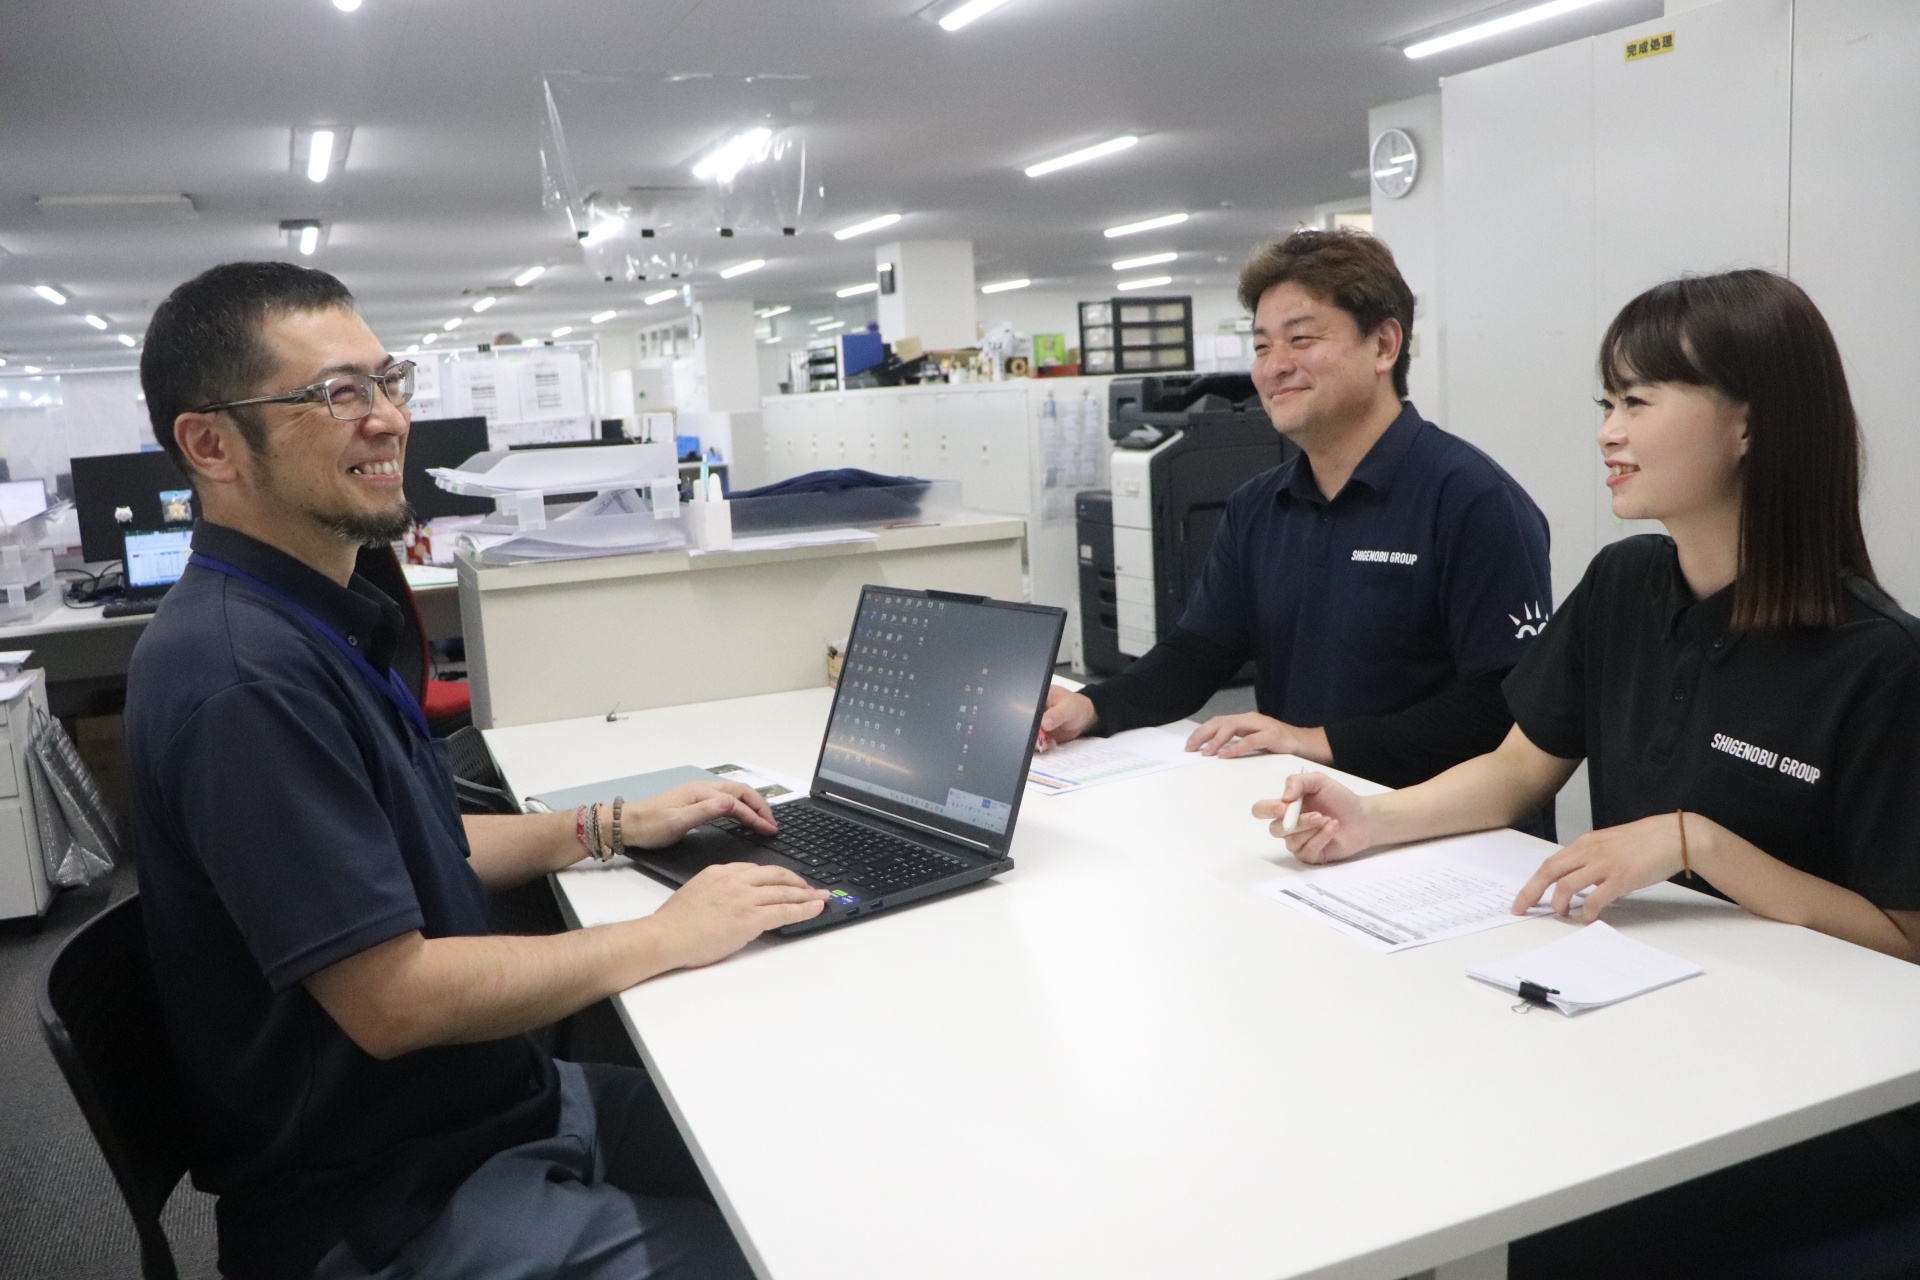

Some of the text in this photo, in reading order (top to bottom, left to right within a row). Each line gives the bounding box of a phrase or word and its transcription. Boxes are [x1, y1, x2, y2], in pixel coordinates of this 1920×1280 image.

[1627, 34, 1673, 58] 完成処理
[1351, 550, 1418, 565] SHIGENOBU GROUP
[1710, 733, 1821, 785] SHIGENOBU GROUP
